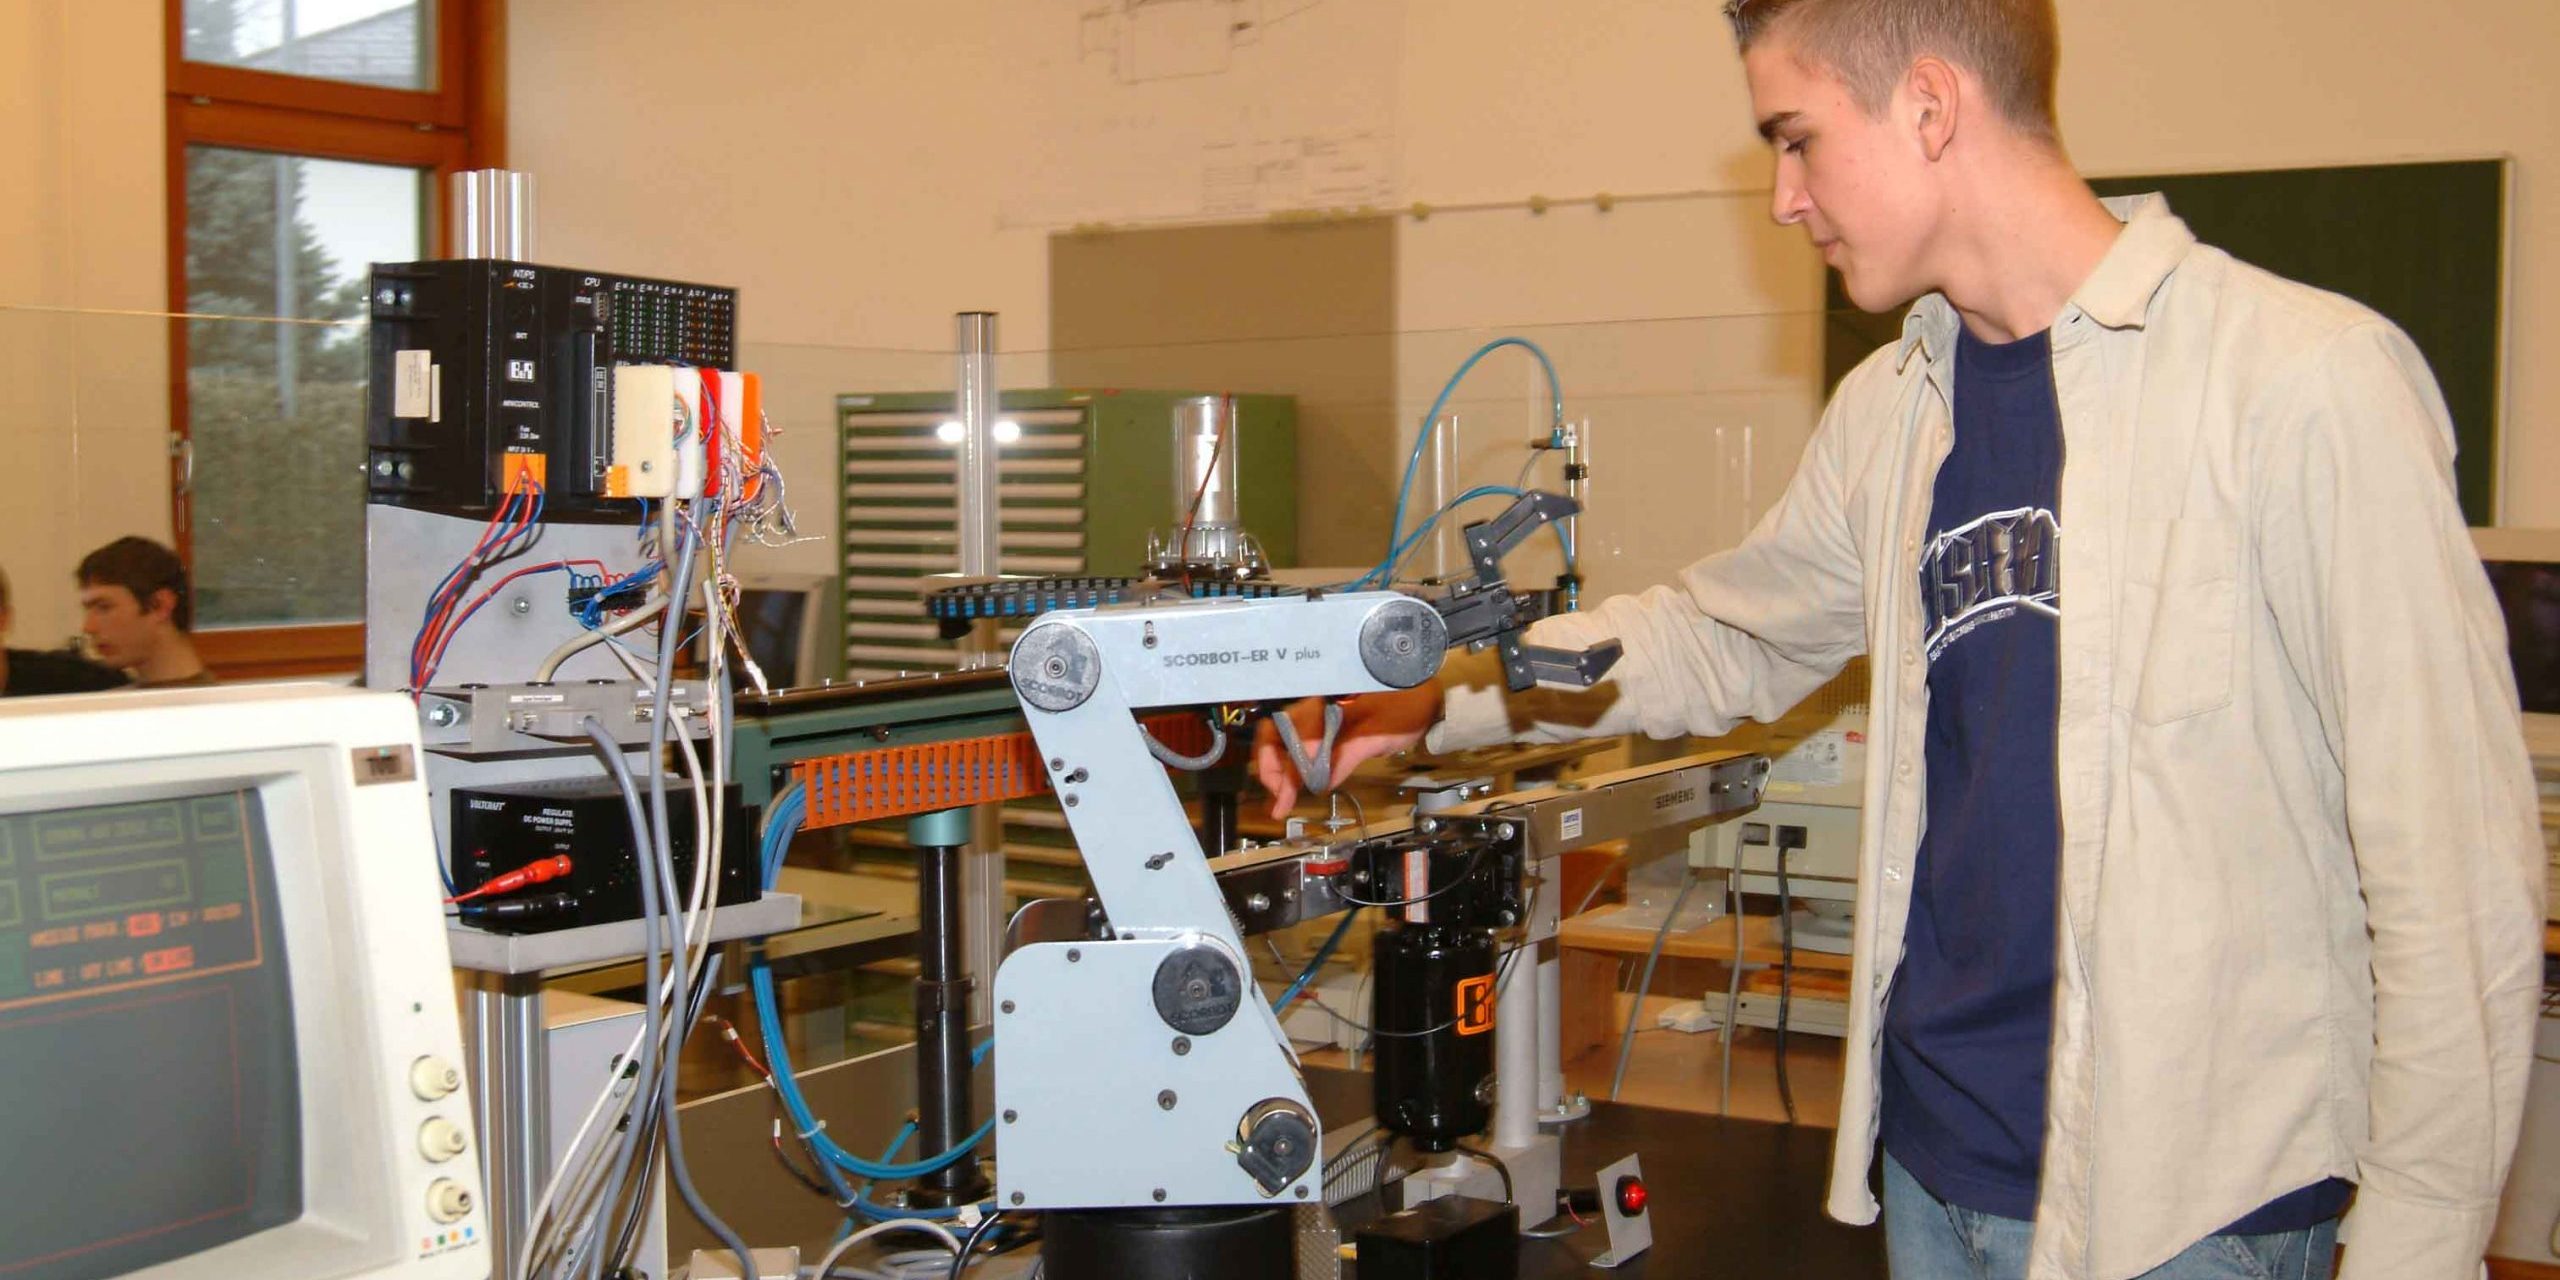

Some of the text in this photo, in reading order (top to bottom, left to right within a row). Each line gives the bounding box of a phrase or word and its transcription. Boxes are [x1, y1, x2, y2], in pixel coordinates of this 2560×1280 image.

[584, 277, 600, 287] CPU
[1163, 646, 1321, 667] SCORBOT-ER V plus
[1655, 788, 1697, 809] SIEMENS
[533, 816, 554, 824] POWER
